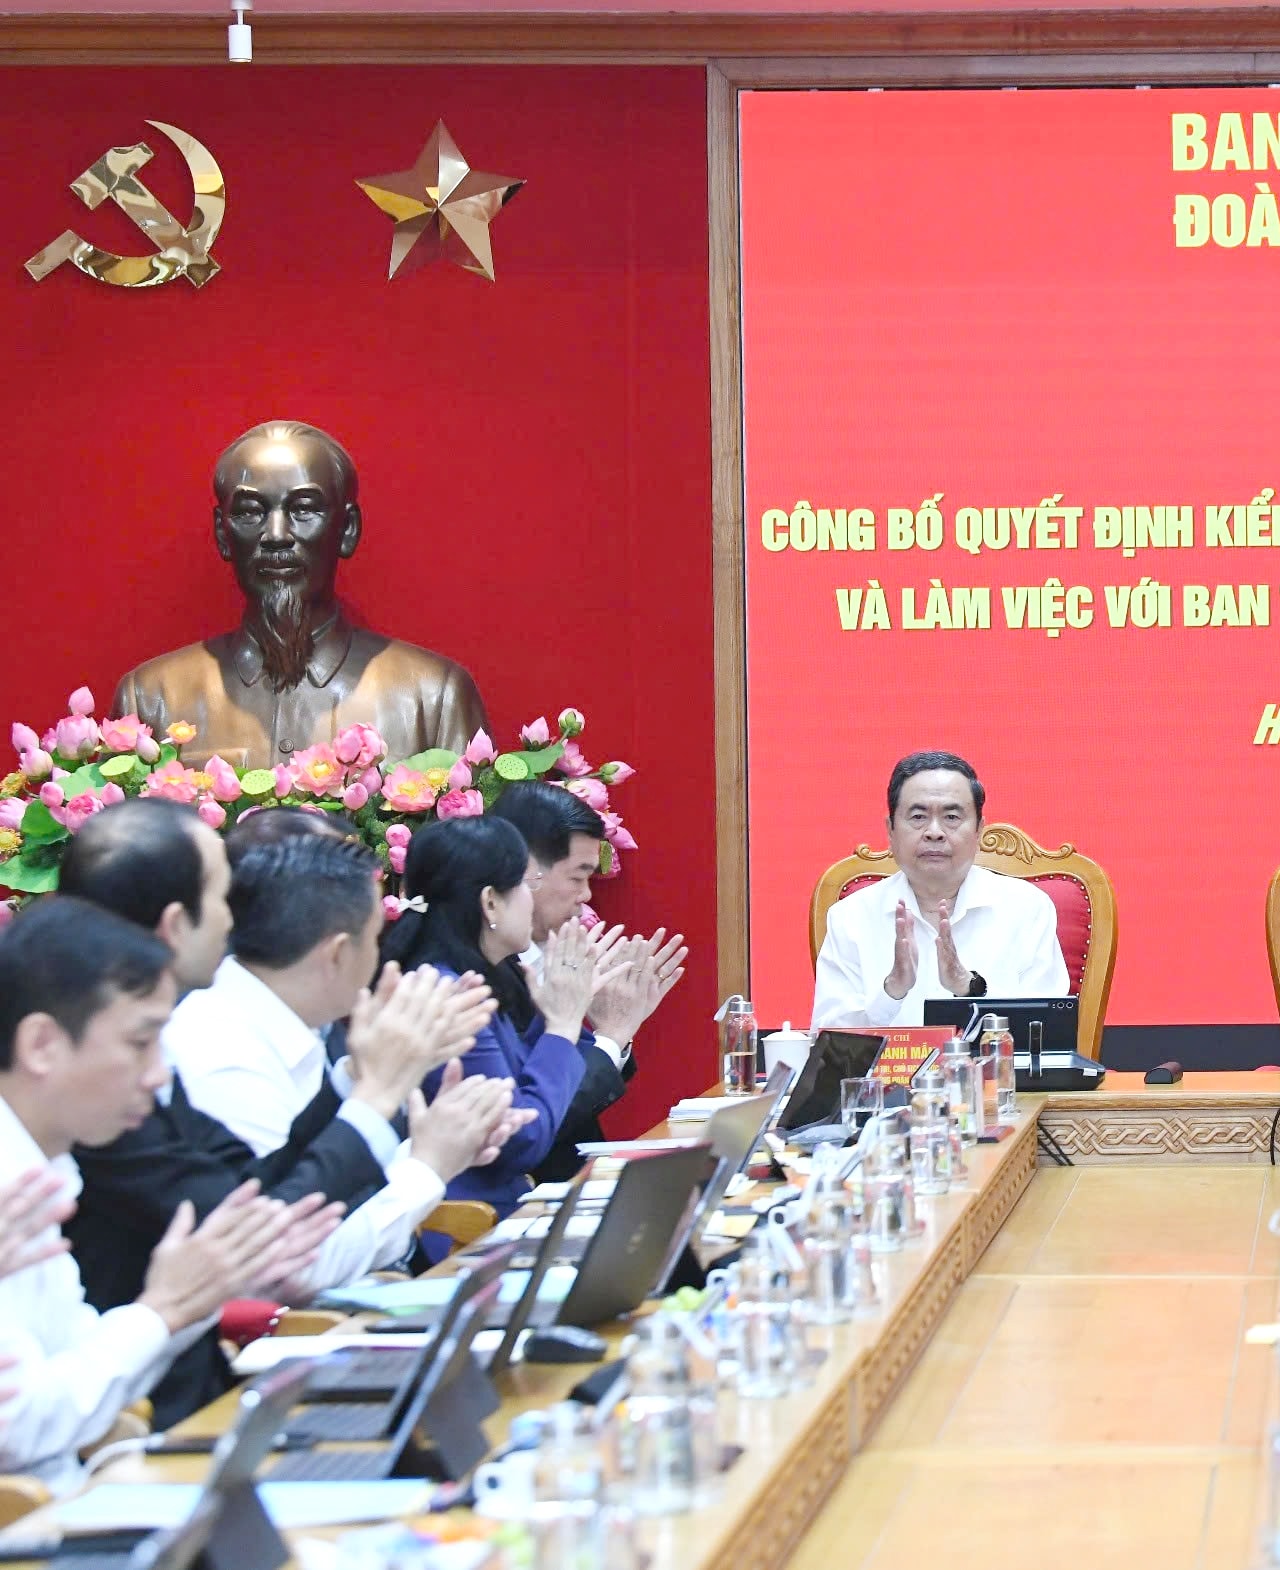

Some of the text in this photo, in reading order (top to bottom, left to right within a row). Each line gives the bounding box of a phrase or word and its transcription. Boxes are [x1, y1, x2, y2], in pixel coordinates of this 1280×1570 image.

[762, 501, 875, 552] CÔNG
[888, 493, 944, 550] BỐ
[956, 494, 1083, 554] QUYẾT
[1093, 506, 1193, 557] ĐỊNH
[836, 580, 890, 631] VÀ
[902, 579, 990, 630] LÀM
[1002, 578, 1093, 638] VIỆC
[1104, 577, 1170, 628] VỚI
[1183, 585, 1269, 627] BAN
[881, 1047, 907, 1059] ANH
